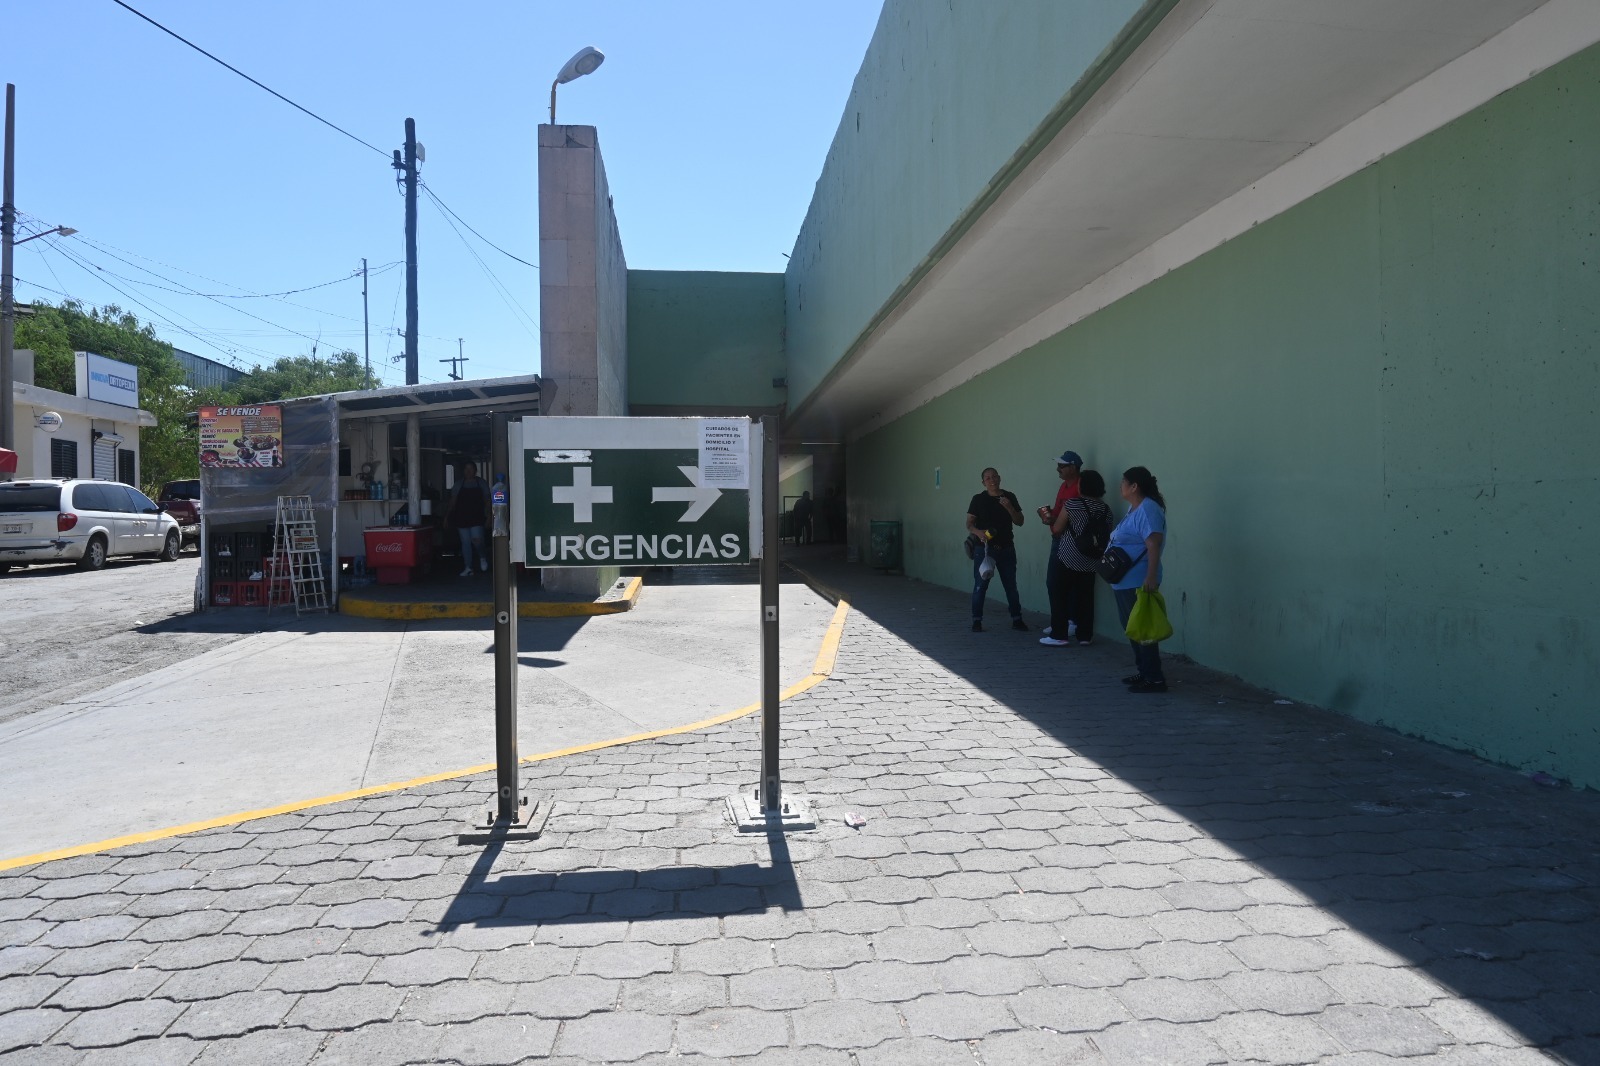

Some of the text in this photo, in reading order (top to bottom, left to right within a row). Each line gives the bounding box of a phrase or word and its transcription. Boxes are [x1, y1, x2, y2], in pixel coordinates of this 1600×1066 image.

[109, 375, 135, 391] ORTOPEDIA
[216, 407, 262, 416] SE VENDE
[534, 533, 741, 561] URGENCIAS
